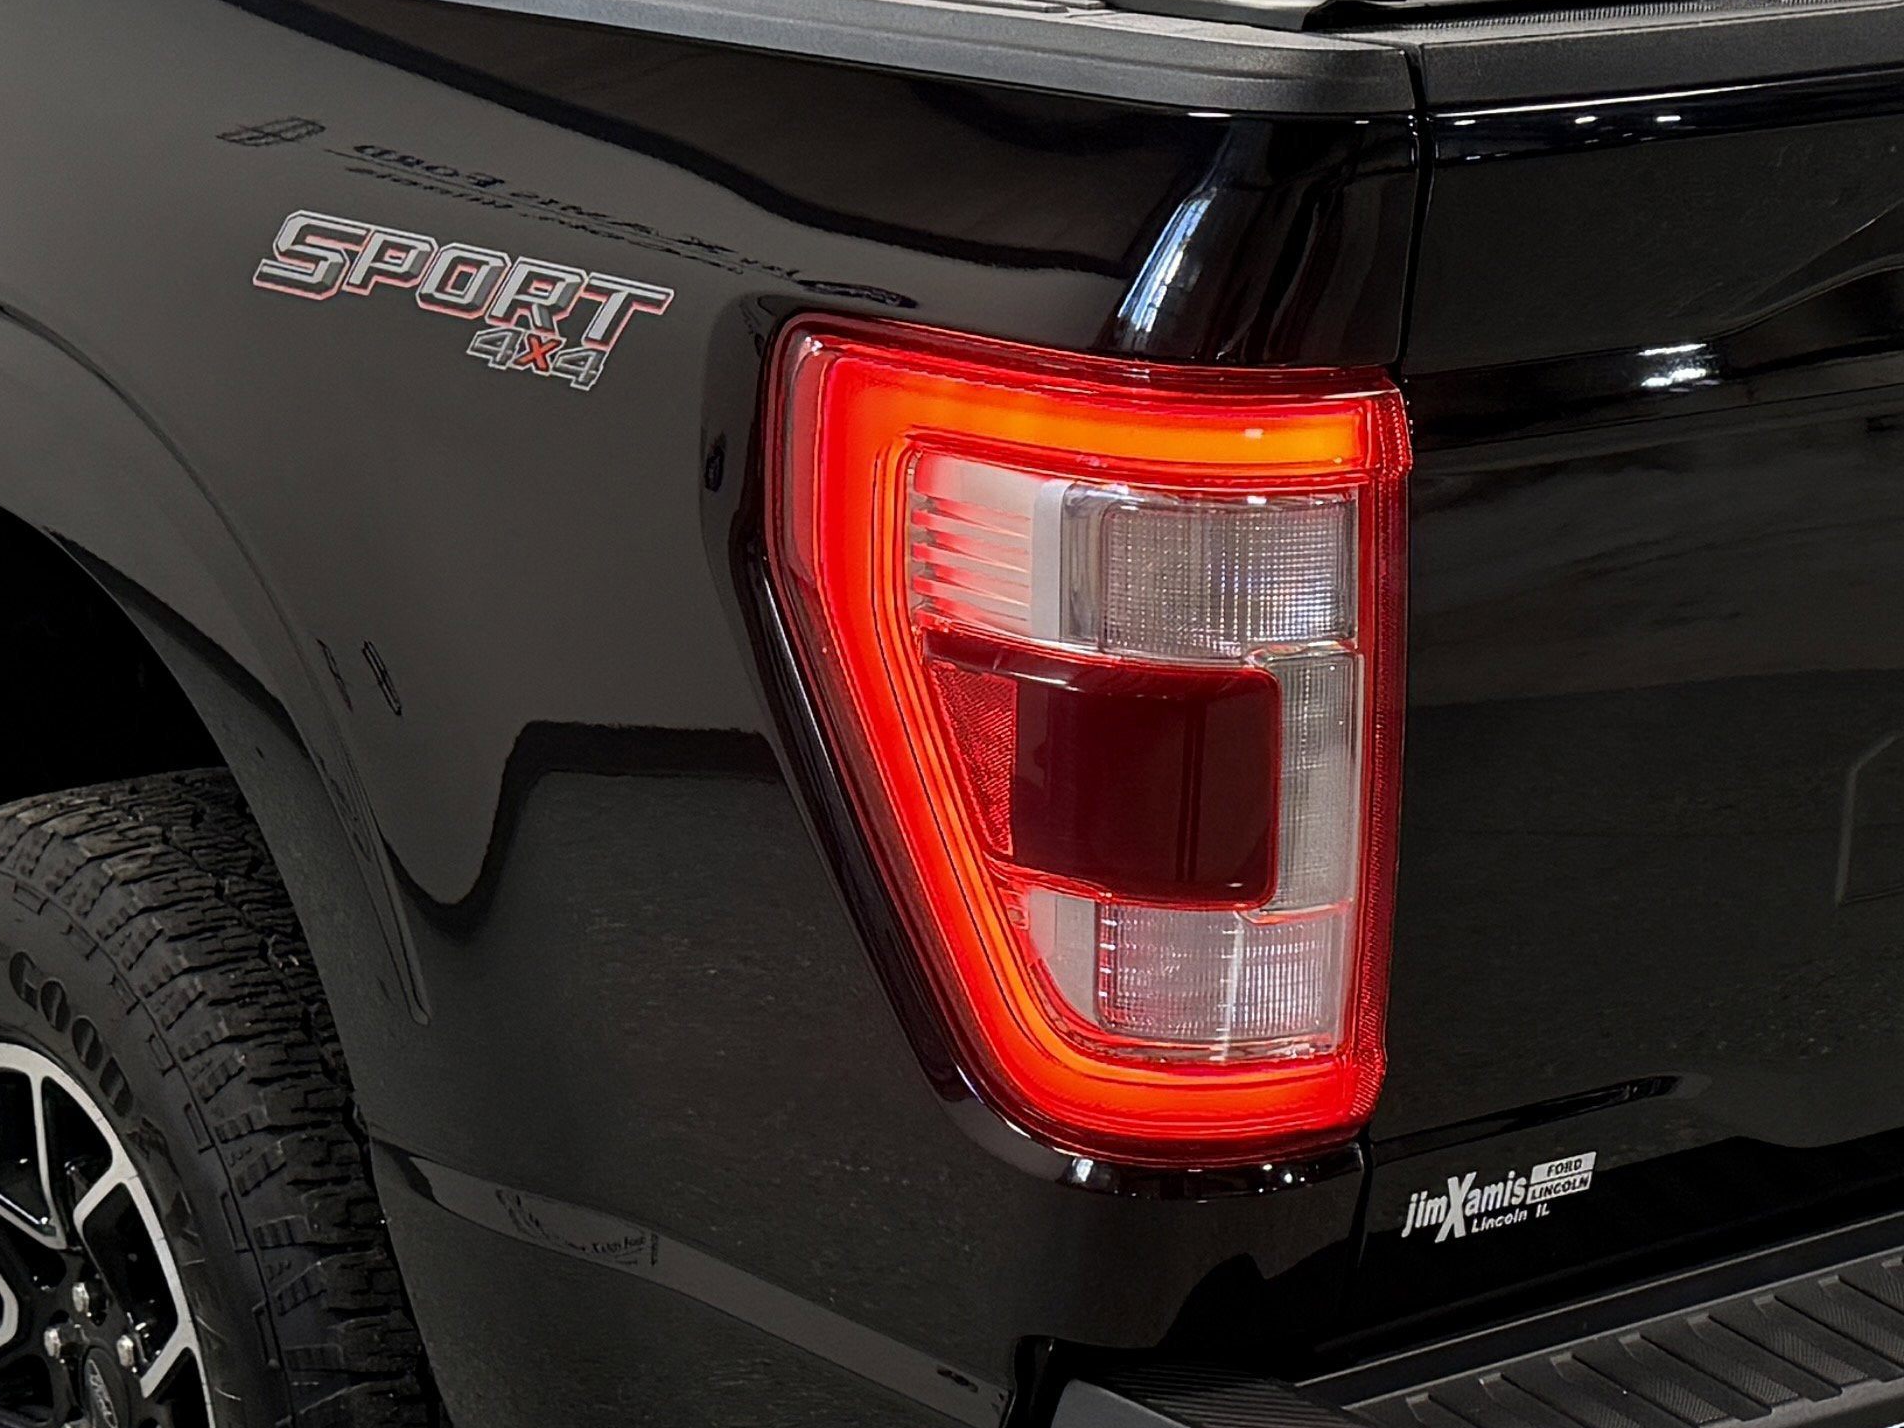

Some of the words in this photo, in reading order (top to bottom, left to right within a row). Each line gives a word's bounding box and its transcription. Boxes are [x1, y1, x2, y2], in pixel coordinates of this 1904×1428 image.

[253, 209, 674, 350] SPORT
[1547, 1158, 1582, 1177] FORD
[1531, 1174, 1589, 1201] LINCOLN
[1471, 1209, 1527, 1233] Lincoln
[1535, 1203, 1550, 1218] IL
